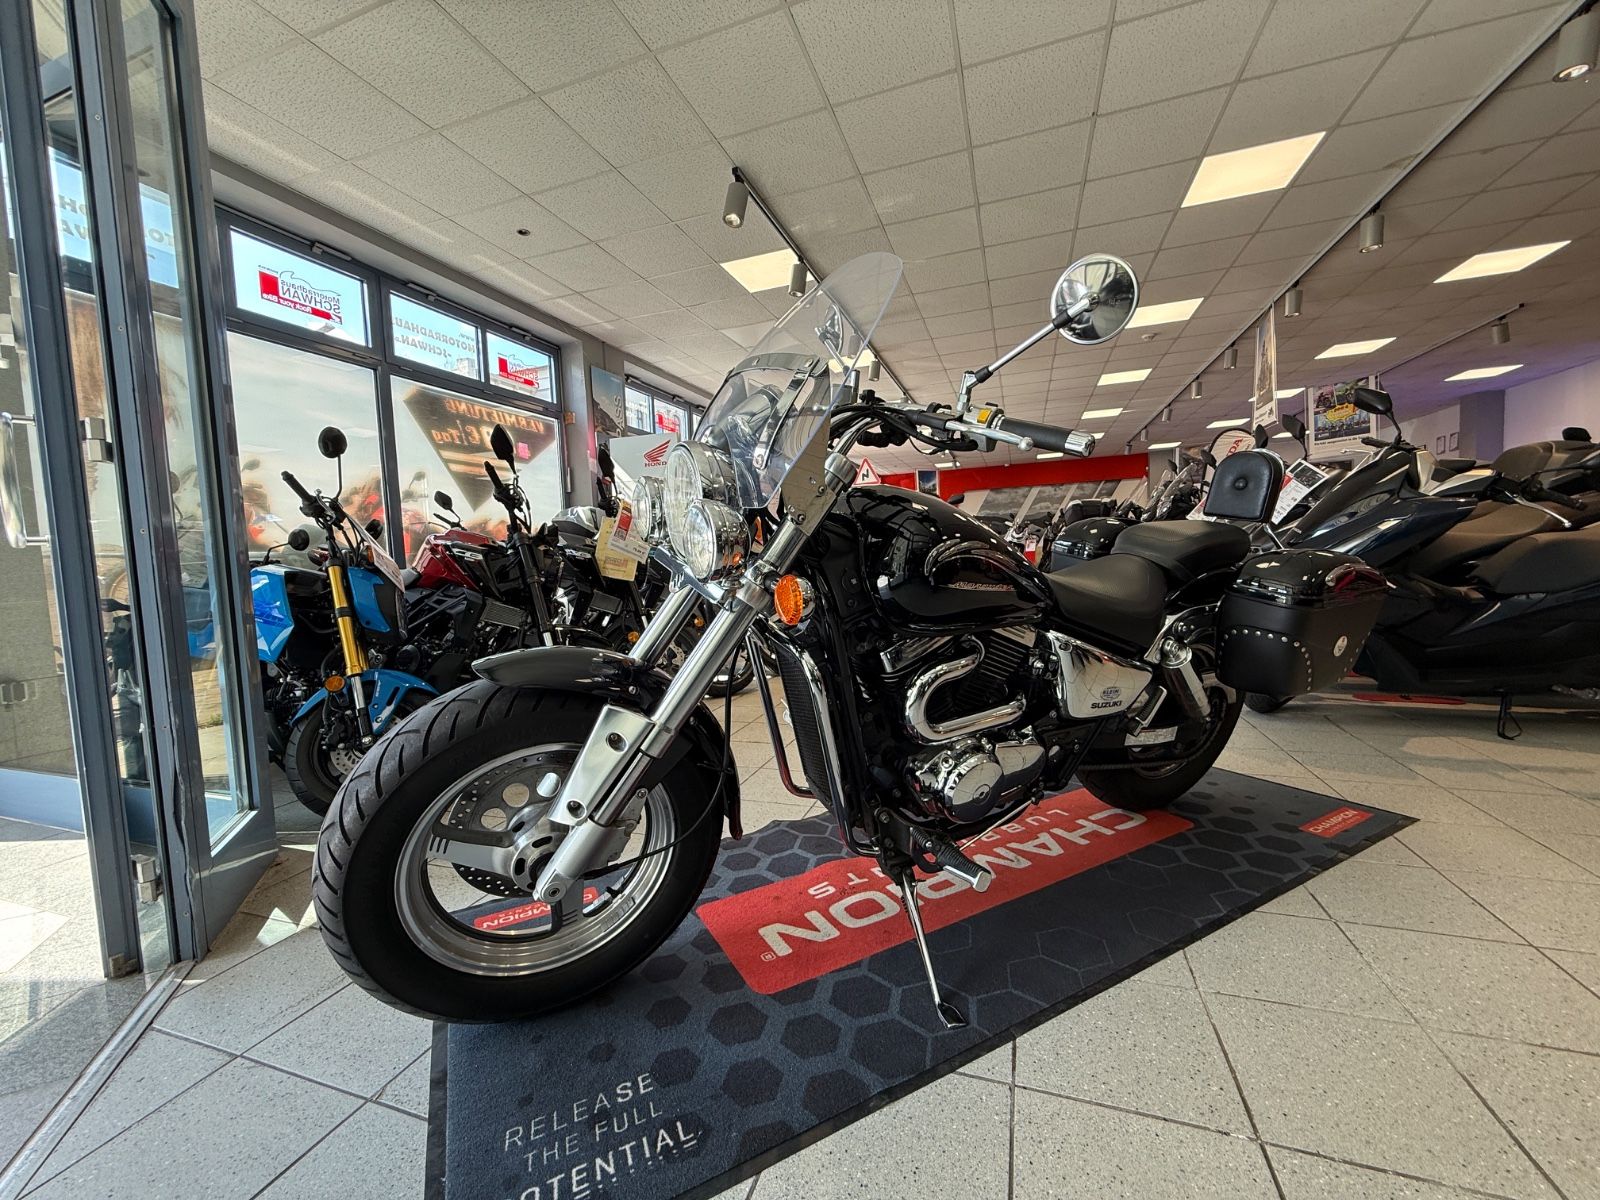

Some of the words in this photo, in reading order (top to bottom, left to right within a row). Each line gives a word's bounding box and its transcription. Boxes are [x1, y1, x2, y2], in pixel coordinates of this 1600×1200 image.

[1090, 700, 1123, 709] SUZUKI
[505, 1073, 653, 1151] RELEASE
[523, 1133, 579, 1172] THE
[595, 1101, 663, 1142] FULL
